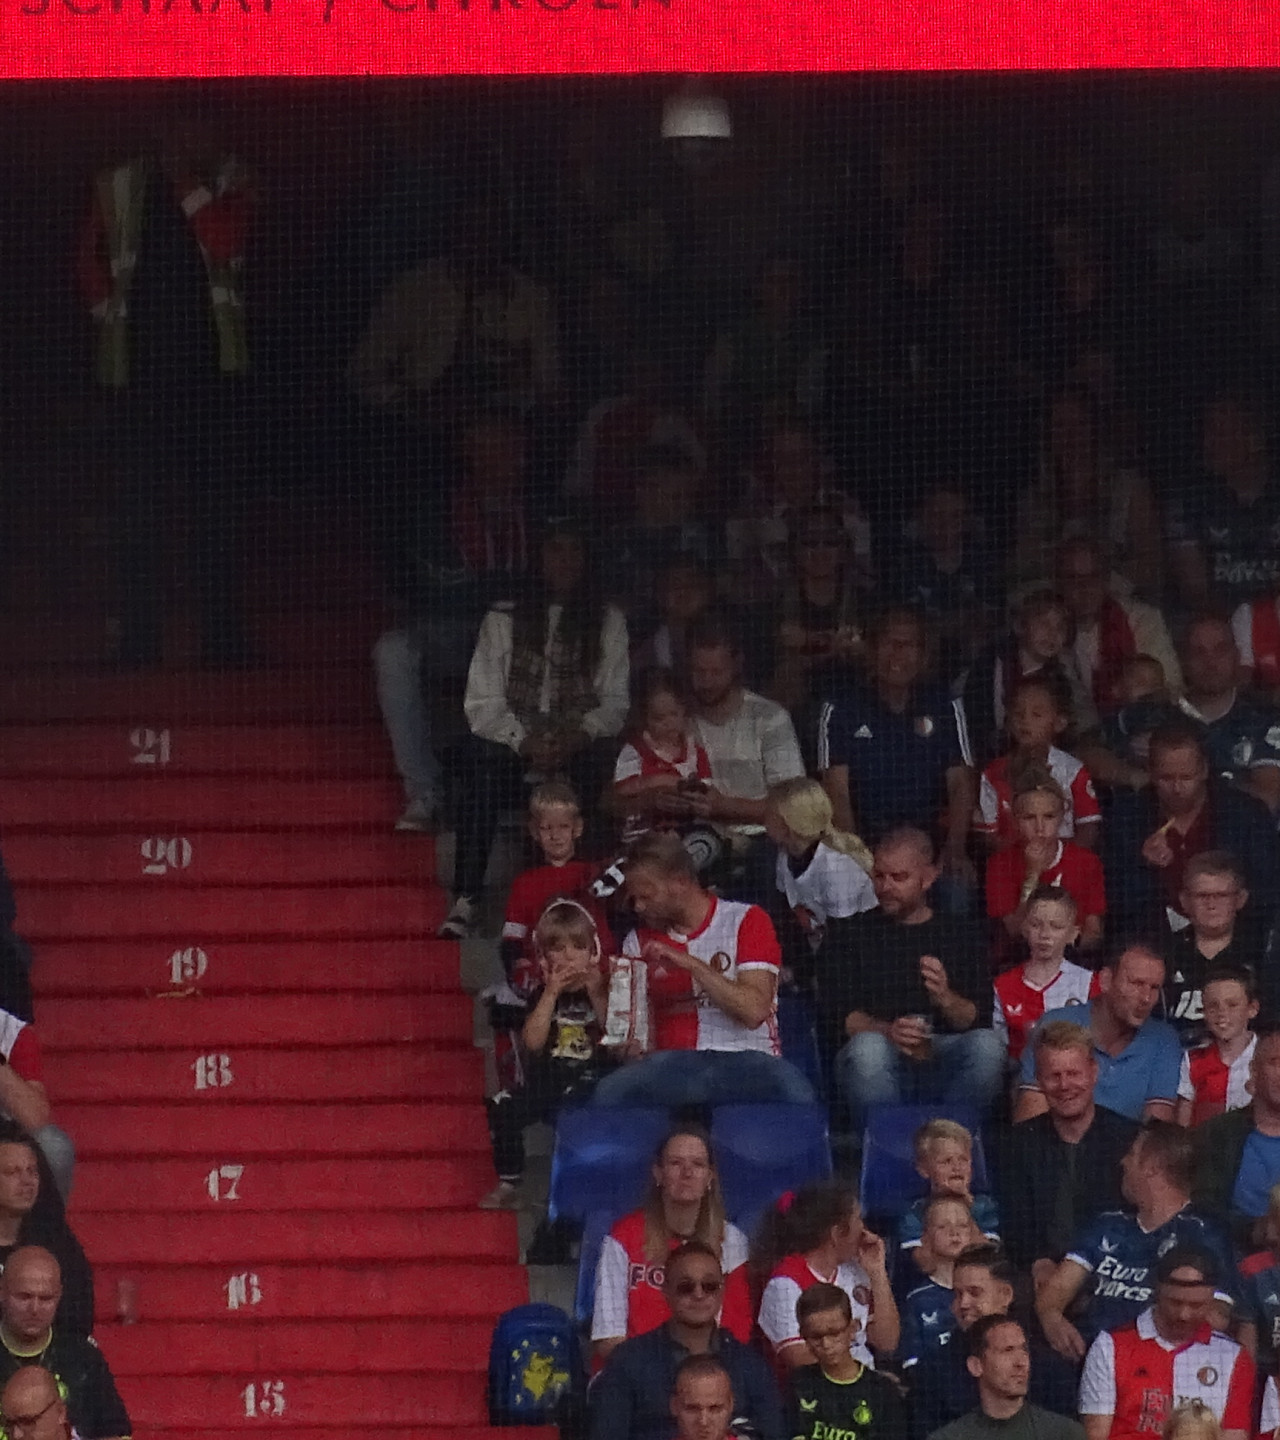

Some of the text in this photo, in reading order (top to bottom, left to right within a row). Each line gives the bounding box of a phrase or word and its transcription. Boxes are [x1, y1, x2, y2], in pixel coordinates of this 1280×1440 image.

[130, 728, 170, 764] 21
[141, 837, 192, 875] 20
[169, 947, 208, 984] 19
[191, 1053, 233, 1090] 18
[204, 1165, 244, 1202] 17
[1097, 1255, 1150, 1283] Euro
[223, 1271, 262, 1310] 16
[240, 1379, 286, 1418] 15
